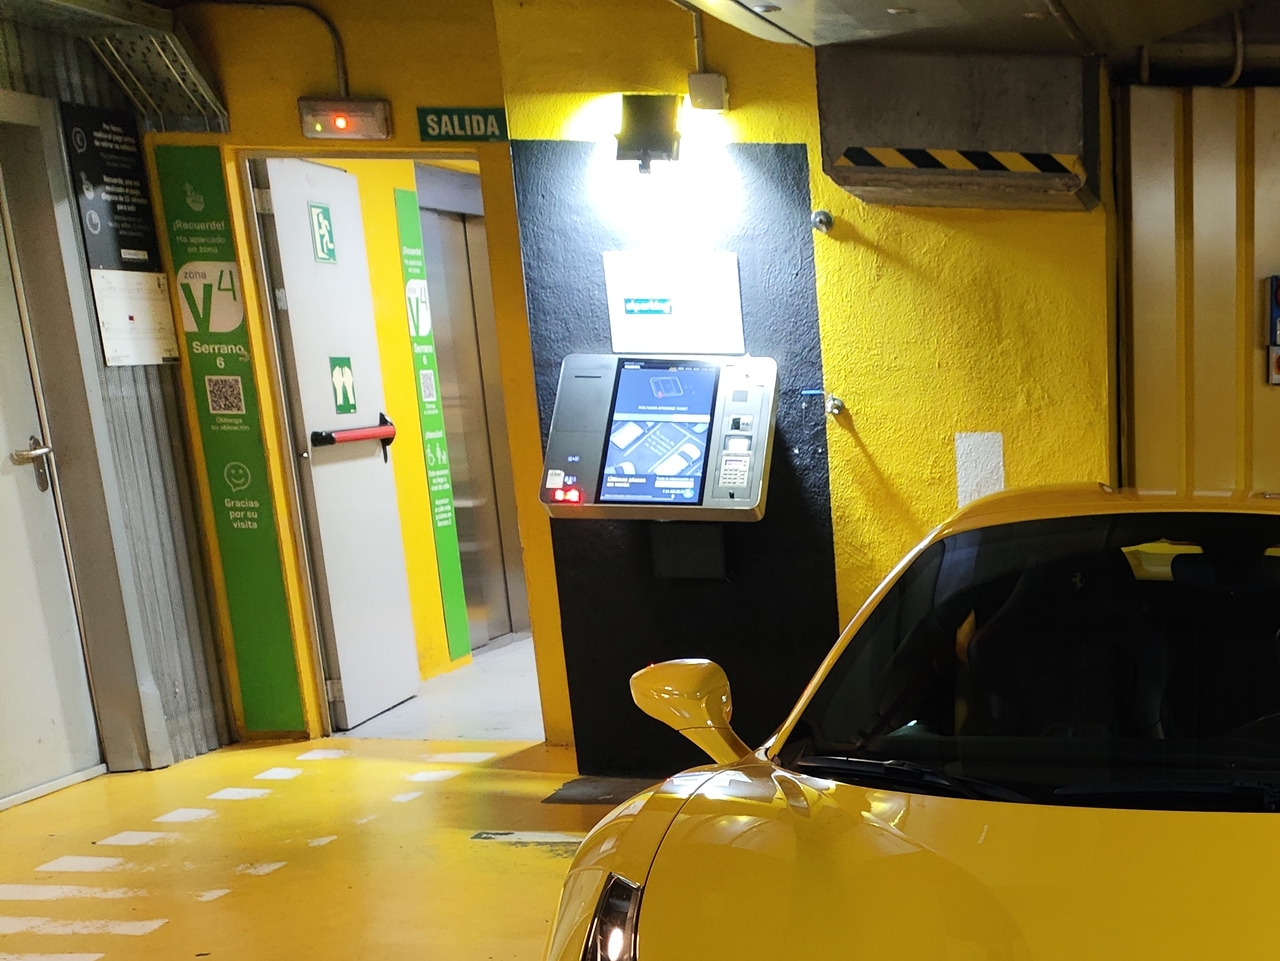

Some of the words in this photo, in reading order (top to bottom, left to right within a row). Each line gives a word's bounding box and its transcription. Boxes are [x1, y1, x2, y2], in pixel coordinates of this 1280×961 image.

[426, 114, 500, 136] SALIDA
[192, 341, 245, 354] Serrano
[216, 357, 225, 368] 6
[224, 498, 259, 508] Gracias
[229, 511, 245, 519] por
[233, 520, 258, 529] visita
